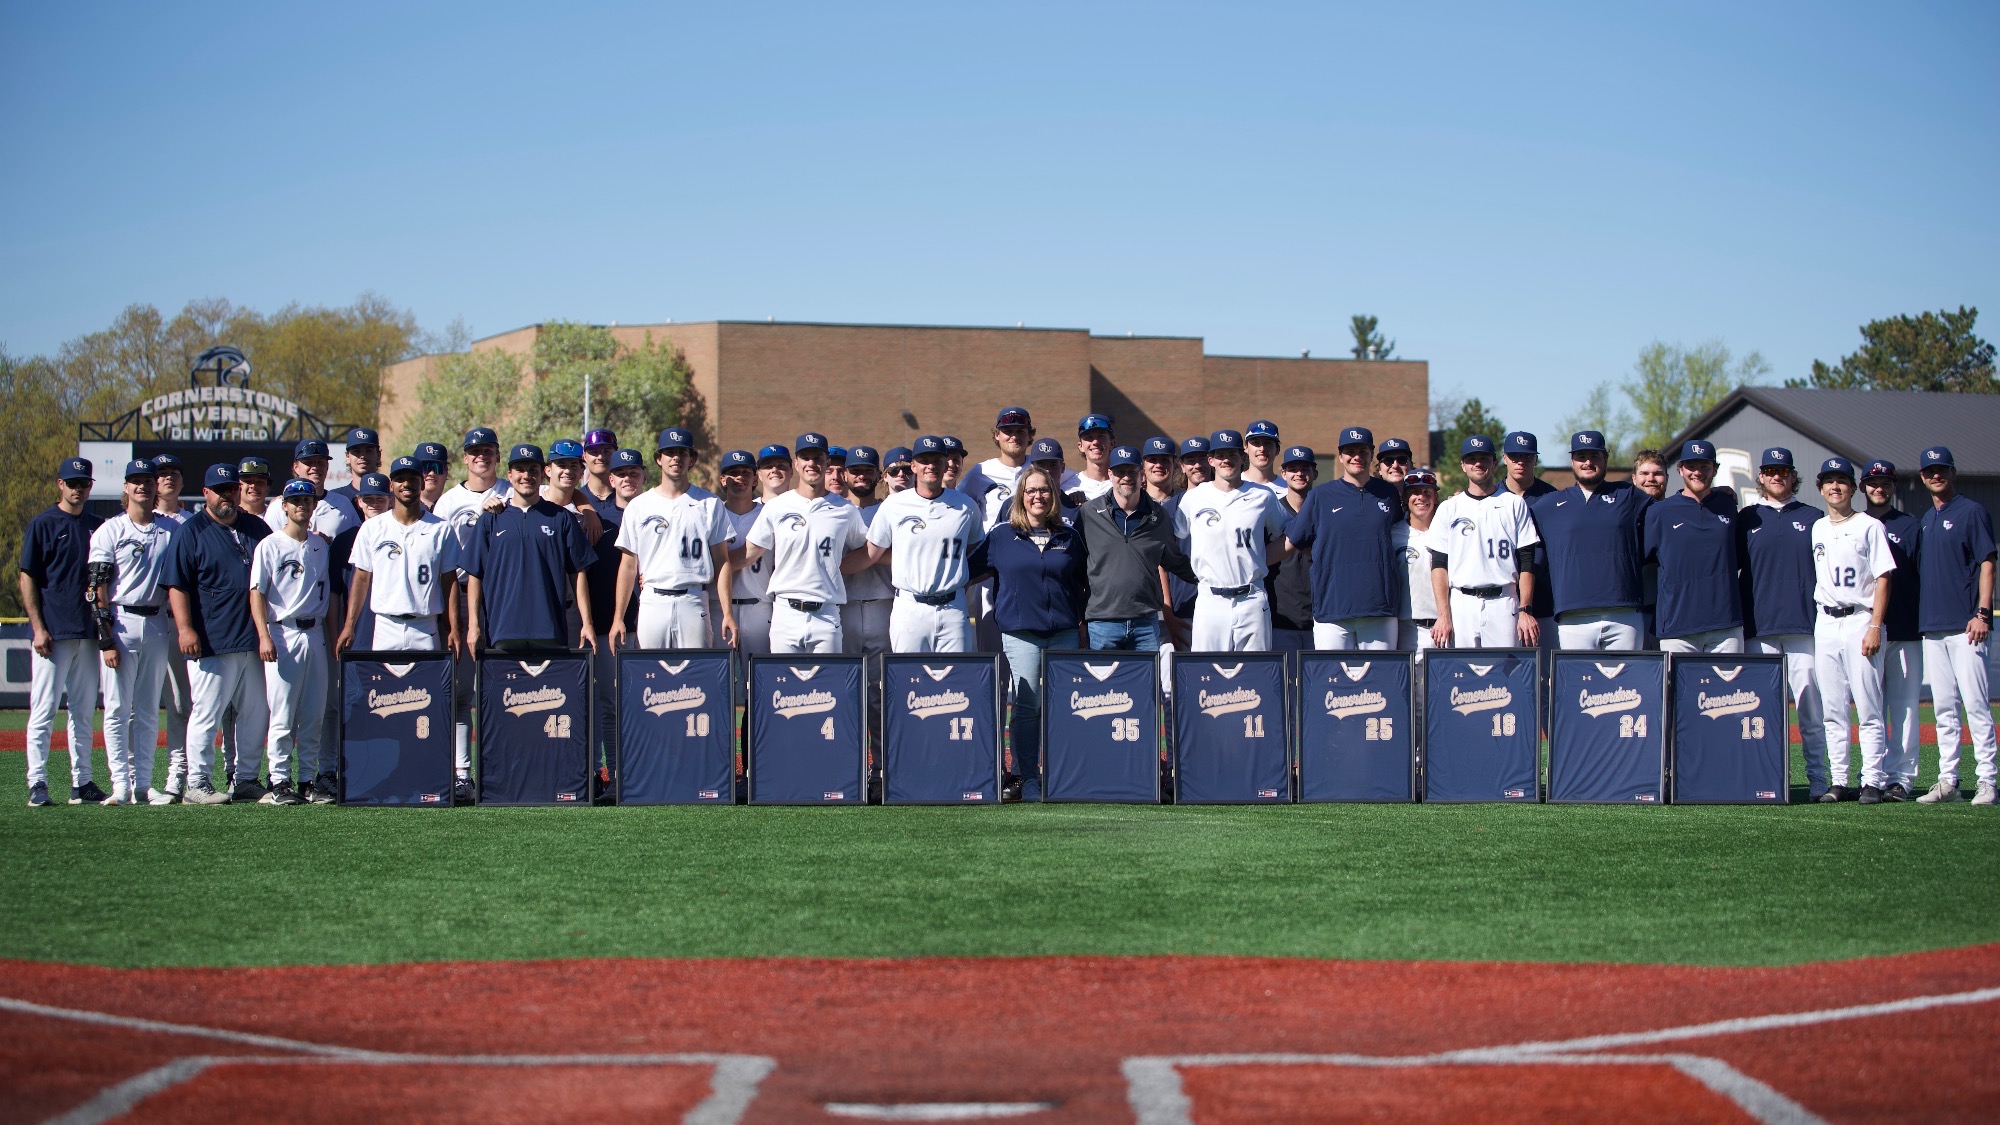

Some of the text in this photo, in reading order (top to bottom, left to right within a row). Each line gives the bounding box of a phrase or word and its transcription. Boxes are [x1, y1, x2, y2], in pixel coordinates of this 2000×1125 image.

[141, 386, 299, 419] CORNERSTONE
[152, 405, 287, 434] UNIVERSITY
[681, 536, 702, 559] 10
[819, 537, 831, 556] 4
[942, 538, 962, 559] 17
[1235, 528, 1252, 547] 11
[1488, 539, 1509, 559] 18
[418, 565, 429, 584] 8
[1834, 567, 1856, 587] 12
[318, 581, 325, 601] 7
[416, 715, 430, 739] 8
[543, 714, 571, 738] 42
[686, 713, 709, 736] 10
[821, 717, 834, 739] 4
[950, 717, 973, 740] 17
[1111, 718, 1140, 741] 35
[1244, 715, 1264, 737] 11
[1366, 718, 1392, 740] 25
[1492, 713, 1515, 736] 18
[1620, 715, 1646, 737] 24
[1741, 717, 1764, 739] 13
